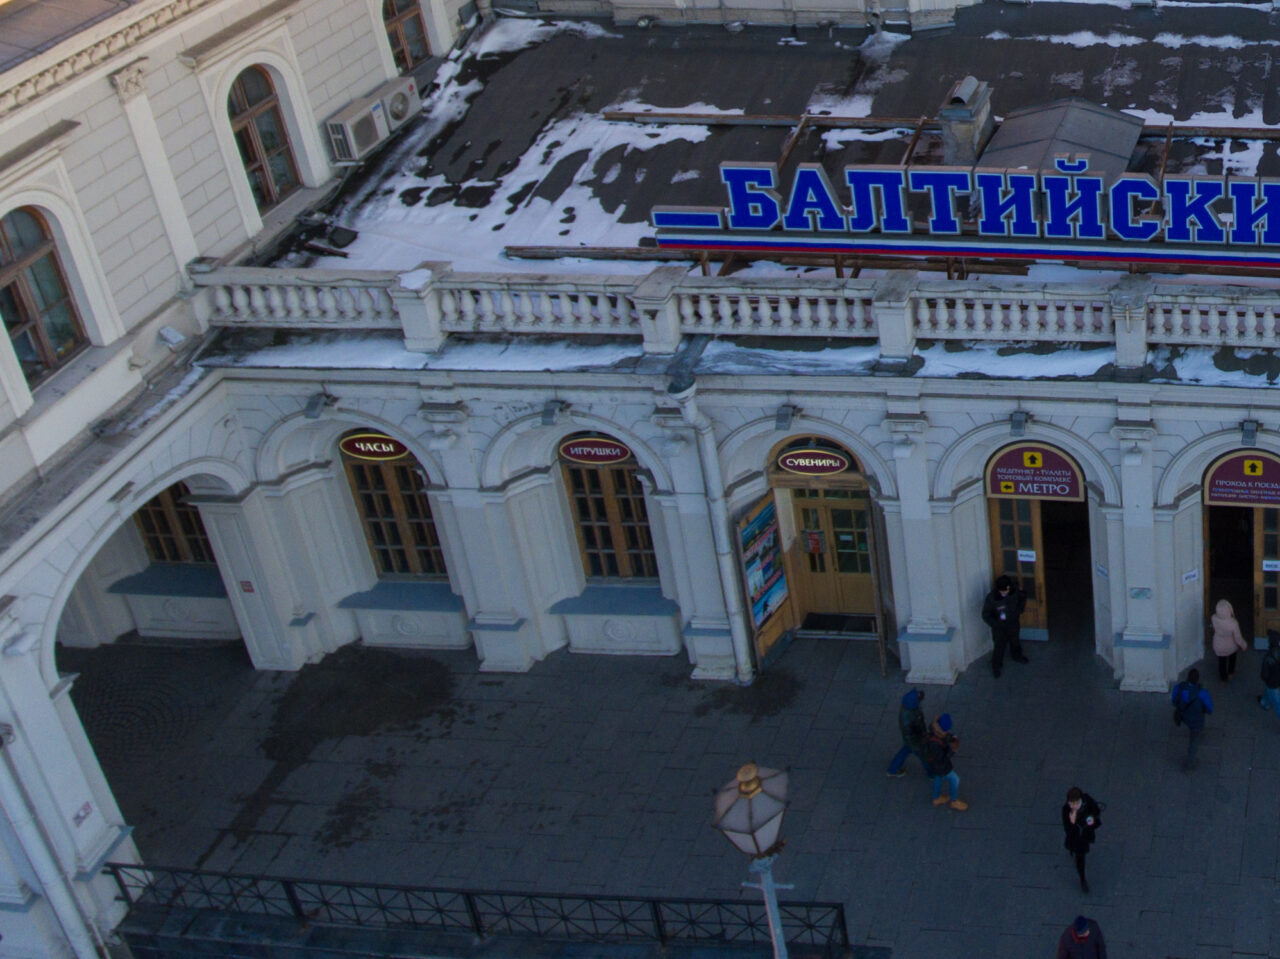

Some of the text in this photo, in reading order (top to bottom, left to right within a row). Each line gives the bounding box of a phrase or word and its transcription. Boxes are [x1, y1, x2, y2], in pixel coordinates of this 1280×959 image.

[354, 442, 395, 453] ЧАСЫ
[569, 447, 622, 456] ИГРУШКИ
[785, 458, 841, 467] СУВЕНИРЫ
[1215, 479, 1248, 488] ПРОХОД
[1018, 482, 1070, 495] МЕТРО
